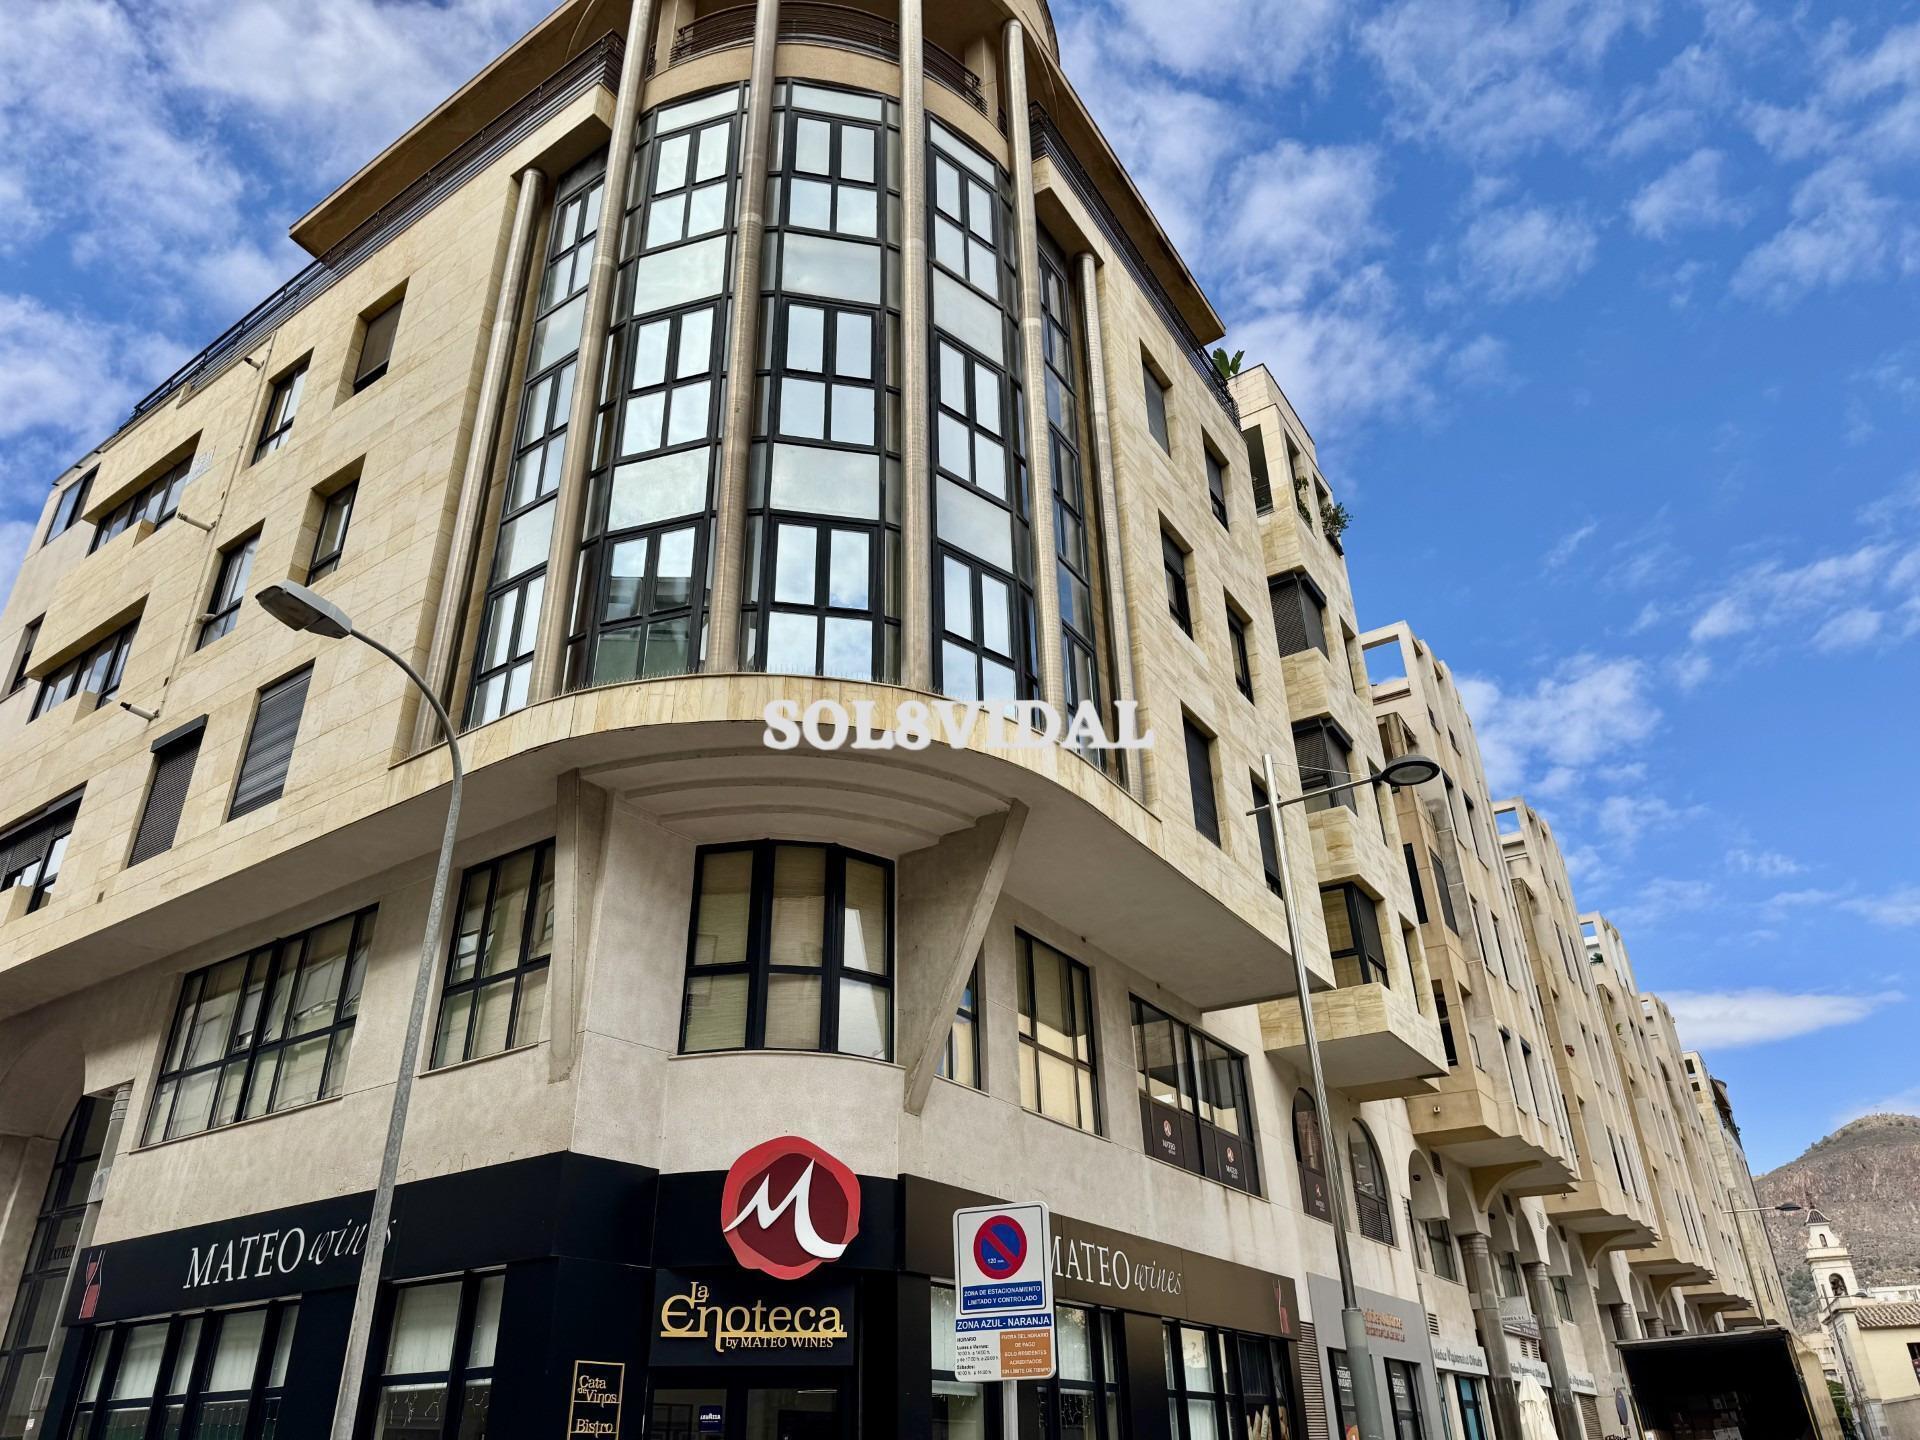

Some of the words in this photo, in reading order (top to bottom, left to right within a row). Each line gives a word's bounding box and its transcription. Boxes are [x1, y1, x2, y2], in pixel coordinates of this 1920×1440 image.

[183, 1228, 305, 1289] MATEO
[308, 1219, 397, 1265] wins
[1134, 1260, 1182, 1295] wines
[987, 1285, 1041, 1295] ESTACIONAMIENTO
[967, 1298, 992, 1306] LIMITADO
[997, 1294, 1038, 1303] CONTROLADO
[661, 1294, 848, 1353] Enoteca
[956, 1321, 980, 1331] ZONA
[1007, 1315, 1050, 1327] NARANJA
[725, 1337, 737, 1350] by
[740, 1336, 788, 1348] MATEO
[791, 1336, 834, 1348] WINES
[579, 1374, 607, 1389] Cata
[585, 1389, 617, 1408] Vinos
[575, 1418, 613, 1438] Bistro
